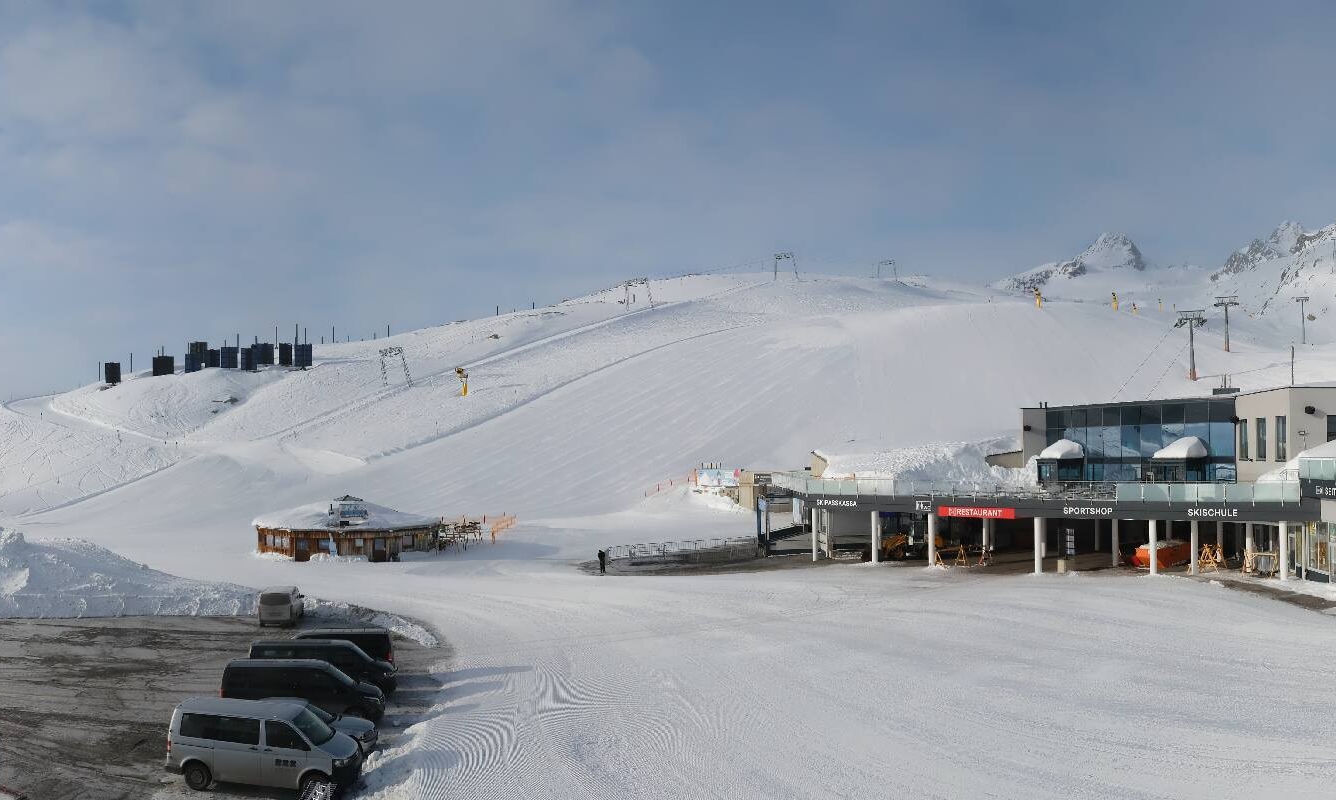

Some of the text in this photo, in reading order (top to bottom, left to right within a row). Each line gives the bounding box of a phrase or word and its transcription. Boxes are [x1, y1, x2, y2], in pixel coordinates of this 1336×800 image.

[956, 508, 1003, 517] RESTAURANT
[1063, 507, 1113, 515] SPORTSHOP
[1187, 508, 1238, 517] SKISCHULE
